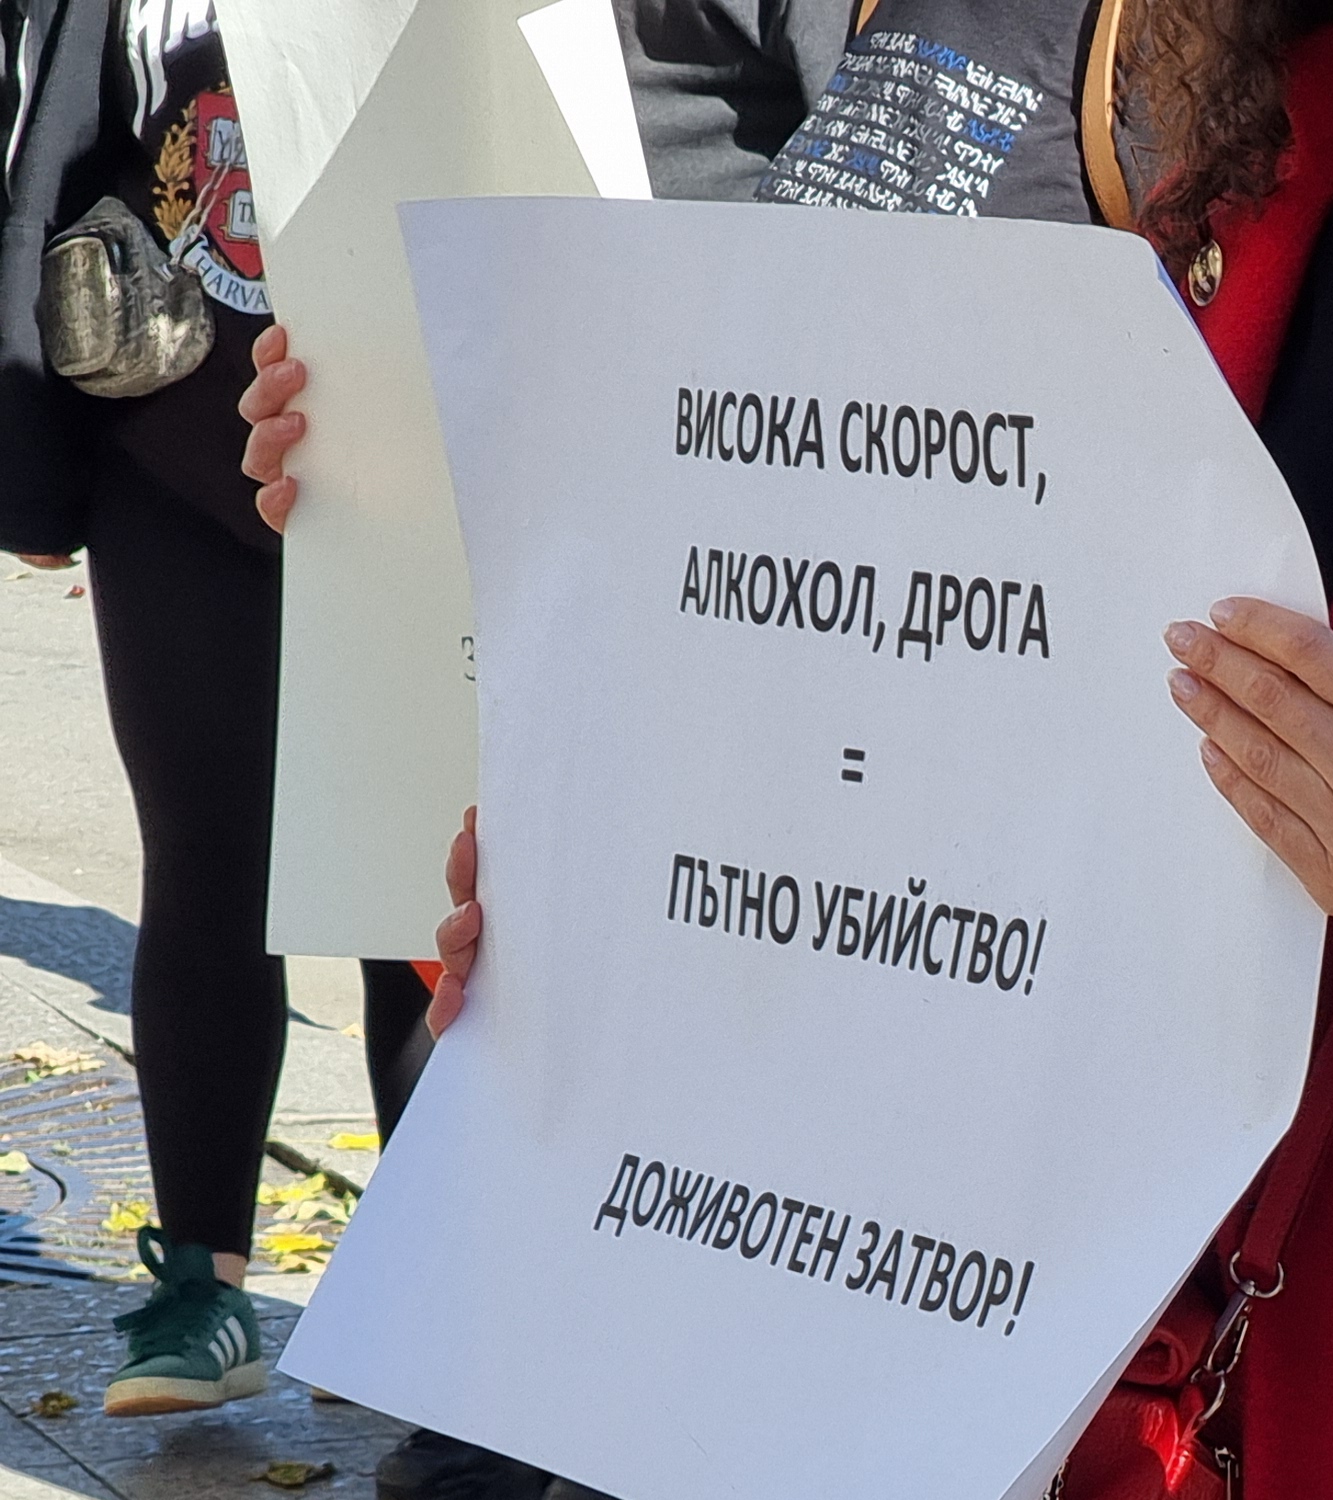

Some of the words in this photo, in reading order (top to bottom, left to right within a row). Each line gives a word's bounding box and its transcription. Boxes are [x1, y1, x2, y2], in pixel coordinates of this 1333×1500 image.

[675, 387, 825, 470] ВИСОКА
[839, 400, 1047, 506] СКОРОСТ,
[679, 545, 887, 654] АЛКОХОЛ,
[896, 570, 1050, 663] ДРОГА
[667, 853, 801, 945] ПЪТНО
[811, 875, 1047, 996] УБИЙСТВО!
[593, 1153, 852, 1283] ДОЖИВОТЕН
[844, 1220, 1036, 1337] ЗАТВОР!
